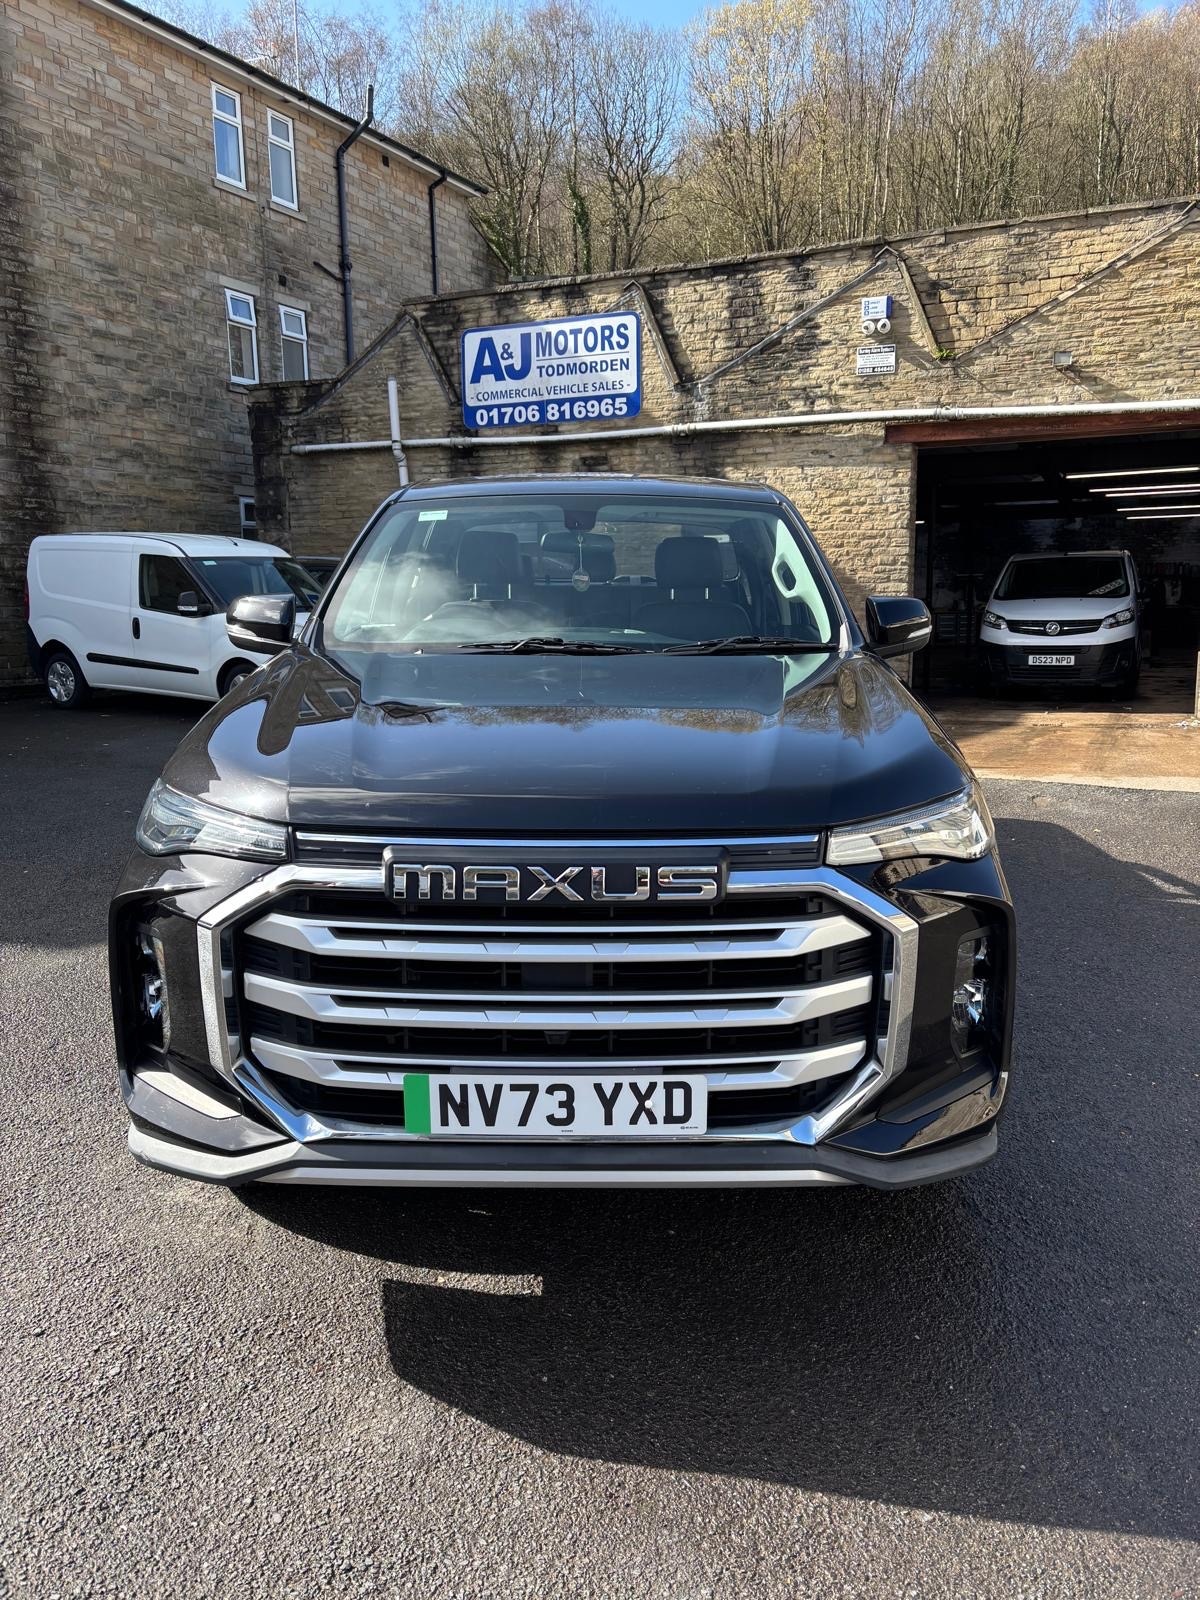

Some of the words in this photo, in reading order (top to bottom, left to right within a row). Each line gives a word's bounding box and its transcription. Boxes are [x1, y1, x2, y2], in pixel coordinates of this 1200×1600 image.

[470, 332, 532, 385] A&J
[535, 323, 629, 358] MOTORS
[536, 358, 630, 378] TODMORDEN
[476, 388, 544, 402] COMMERCIAL
[545, 383, 589, 396] VEHICLE
[592, 380, 624, 392] SALES
[476, 405, 540, 426] 01706
[546, 398, 628, 421] 816965
[1032, 656, 1054, 665] DS23
[1055, 656, 1072, 665] NPD
[393, 864, 718, 900] MAXUS
[438, 1083, 576, 1127] NV73
[593, 1081, 693, 1126] YXD
